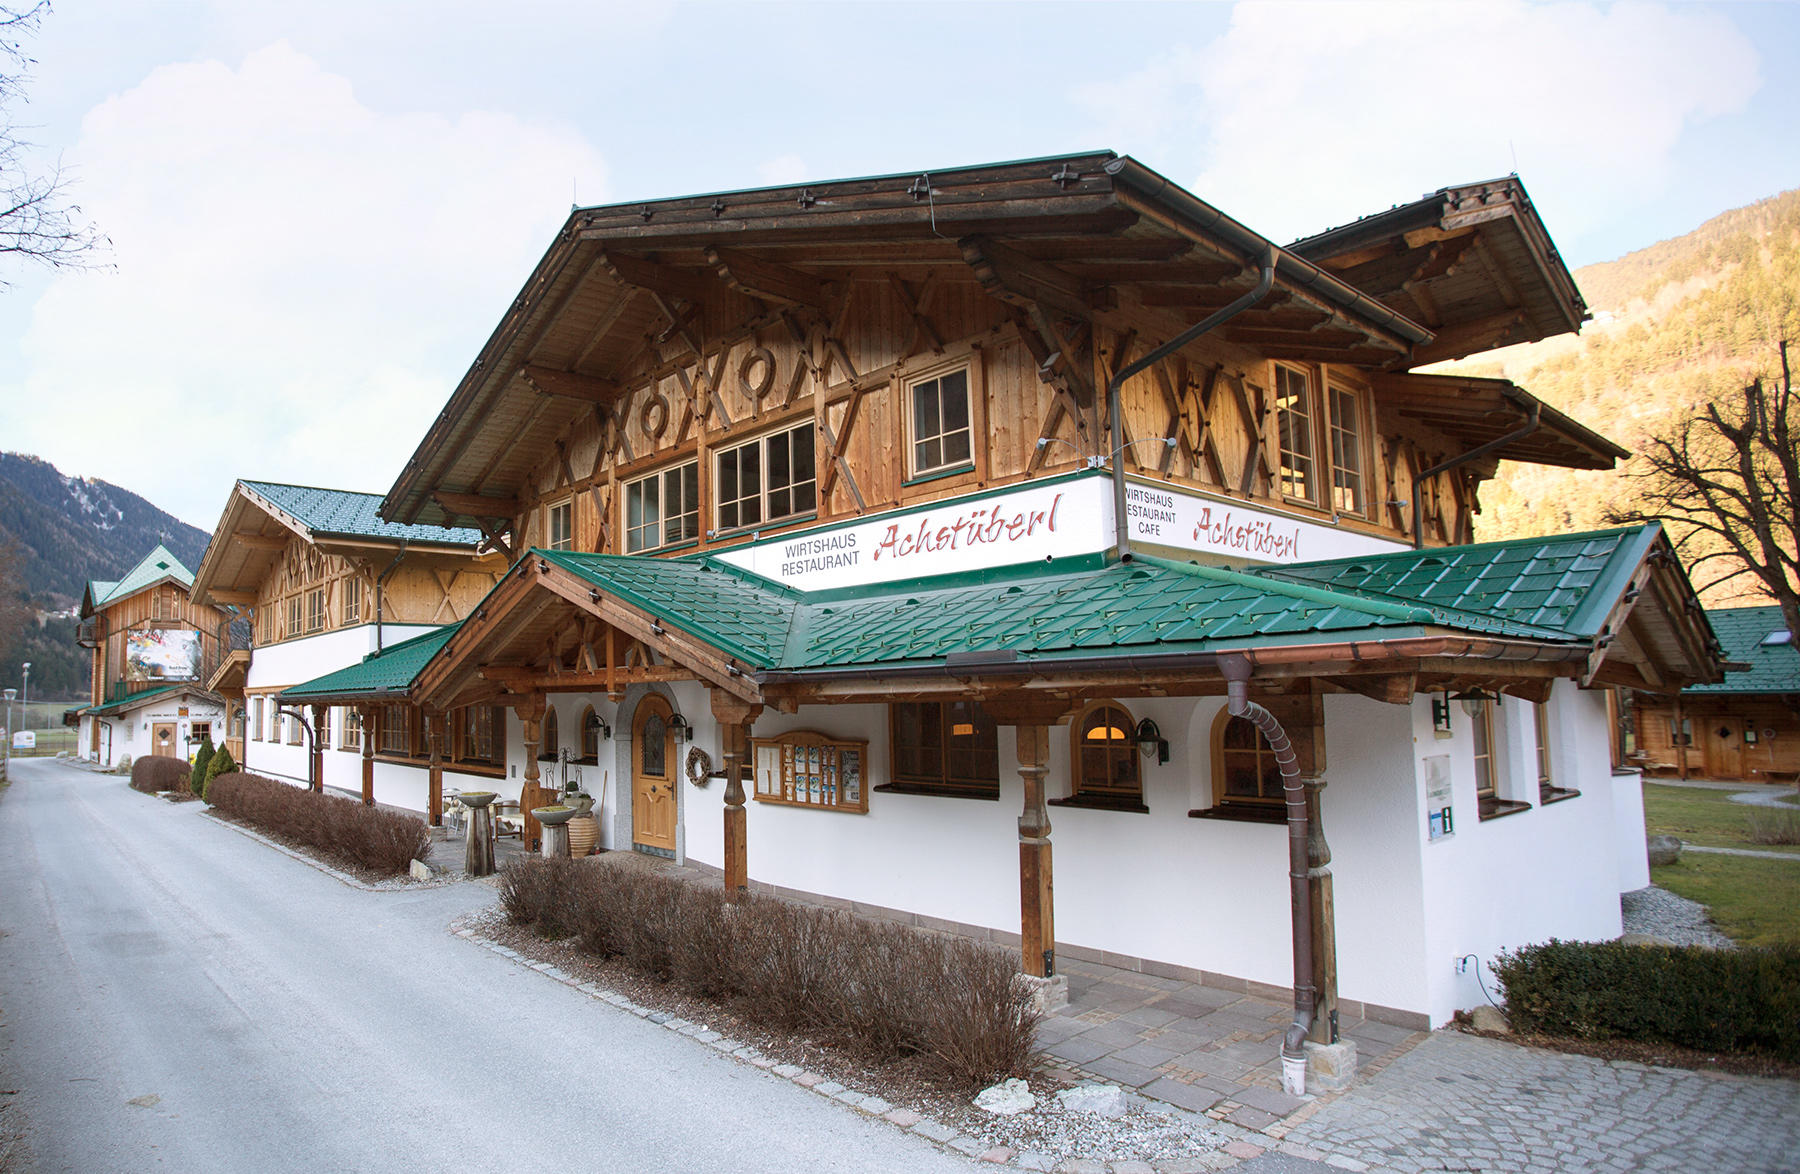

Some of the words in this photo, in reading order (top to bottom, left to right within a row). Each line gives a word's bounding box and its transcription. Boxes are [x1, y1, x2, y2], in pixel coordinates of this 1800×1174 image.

[1127, 503, 1176, 524] ESTAURANT
[873, 492, 1065, 562] Achstüberl
[1138, 521, 1161, 536] CAFE
[1193, 507, 1300, 559] Achstüberl
[785, 533, 857, 559] WIRTSHAUS
[781, 550, 861, 577] RESTAURANT
